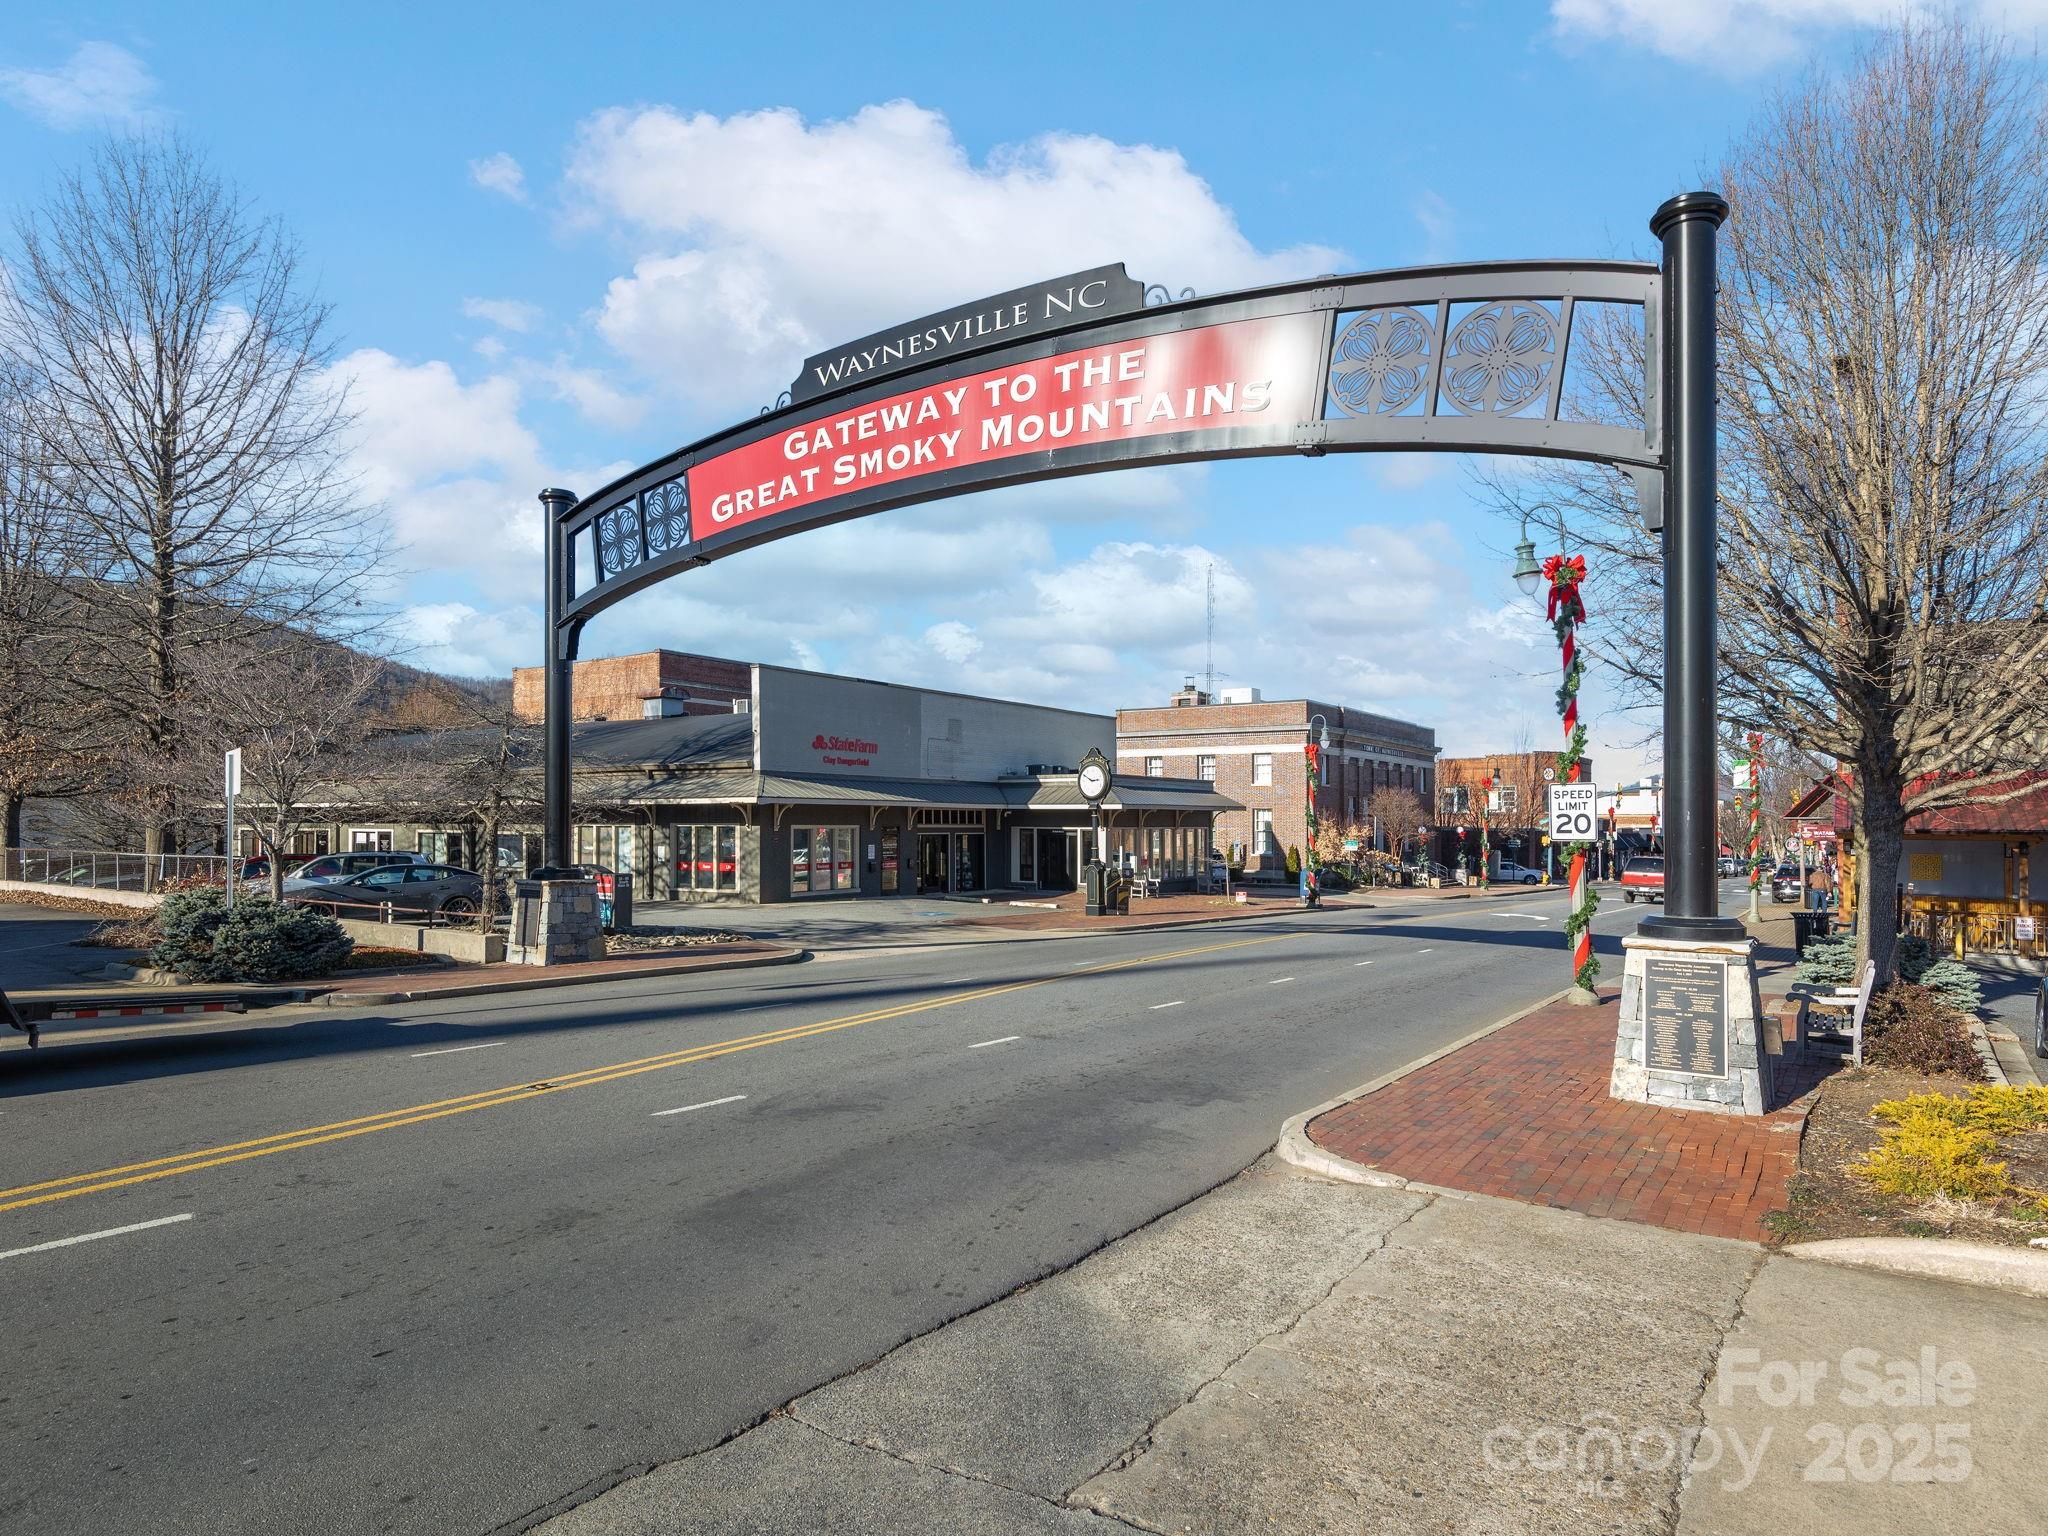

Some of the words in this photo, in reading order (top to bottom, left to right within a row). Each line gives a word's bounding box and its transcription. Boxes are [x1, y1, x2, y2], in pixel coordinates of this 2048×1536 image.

[814, 302, 1028, 387] WAYNESVILLE
[1043, 281, 1108, 319] NC
[783, 387, 968, 460] GATEWAY
[984, 374, 1037, 408] TO
[1054, 349, 1146, 393] THE
[711, 466, 820, 523] GREAT
[833, 429, 963, 486] SMOKY
[980, 378, 1273, 451] MOUNTAINS
[1554, 790, 1593, 800] SPEED
[1556, 813, 1592, 834] 20
[1558, 802, 1588, 811] LIMIT
